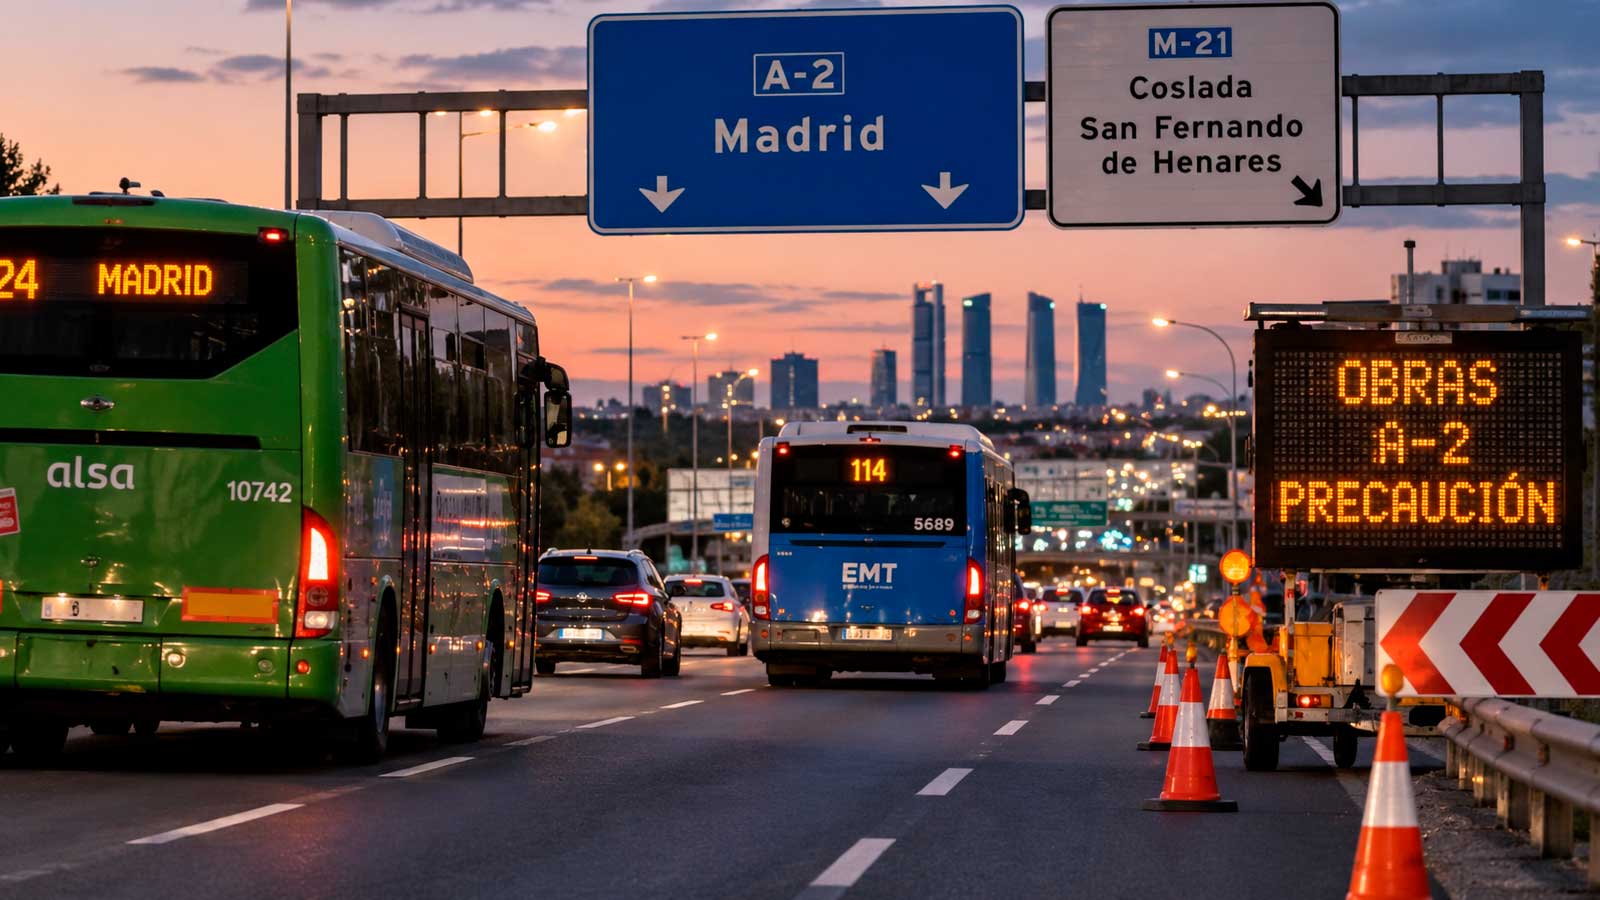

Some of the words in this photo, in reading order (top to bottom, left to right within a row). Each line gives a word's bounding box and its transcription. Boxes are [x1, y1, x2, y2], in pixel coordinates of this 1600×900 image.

[1154, 31, 1227, 55] M-21
[762, 58, 835, 91] A-2
[1129, 75, 1253, 100] Coslada
[714, 114, 884, 154] Madrid
[1080, 116, 1138, 140] San
[1155, 113, 1304, 140] Fernando
[1101, 151, 1137, 175] de
[1153, 150, 1282, 174] Henares
[0, 258, 40, 300] 24
[97, 263, 214, 297] MADRID
[1337, 359, 1498, 406] OBRAS
[1373, 421, 1470, 465] A-2
[46, 455, 135, 490] alsa
[850, 458, 887, 483] 114
[227, 480, 293, 503] 10742
[1278, 472, 1556, 524] PRECAUCIÓN
[913, 517, 955, 532] 5689
[842, 562, 898, 584] EMT
